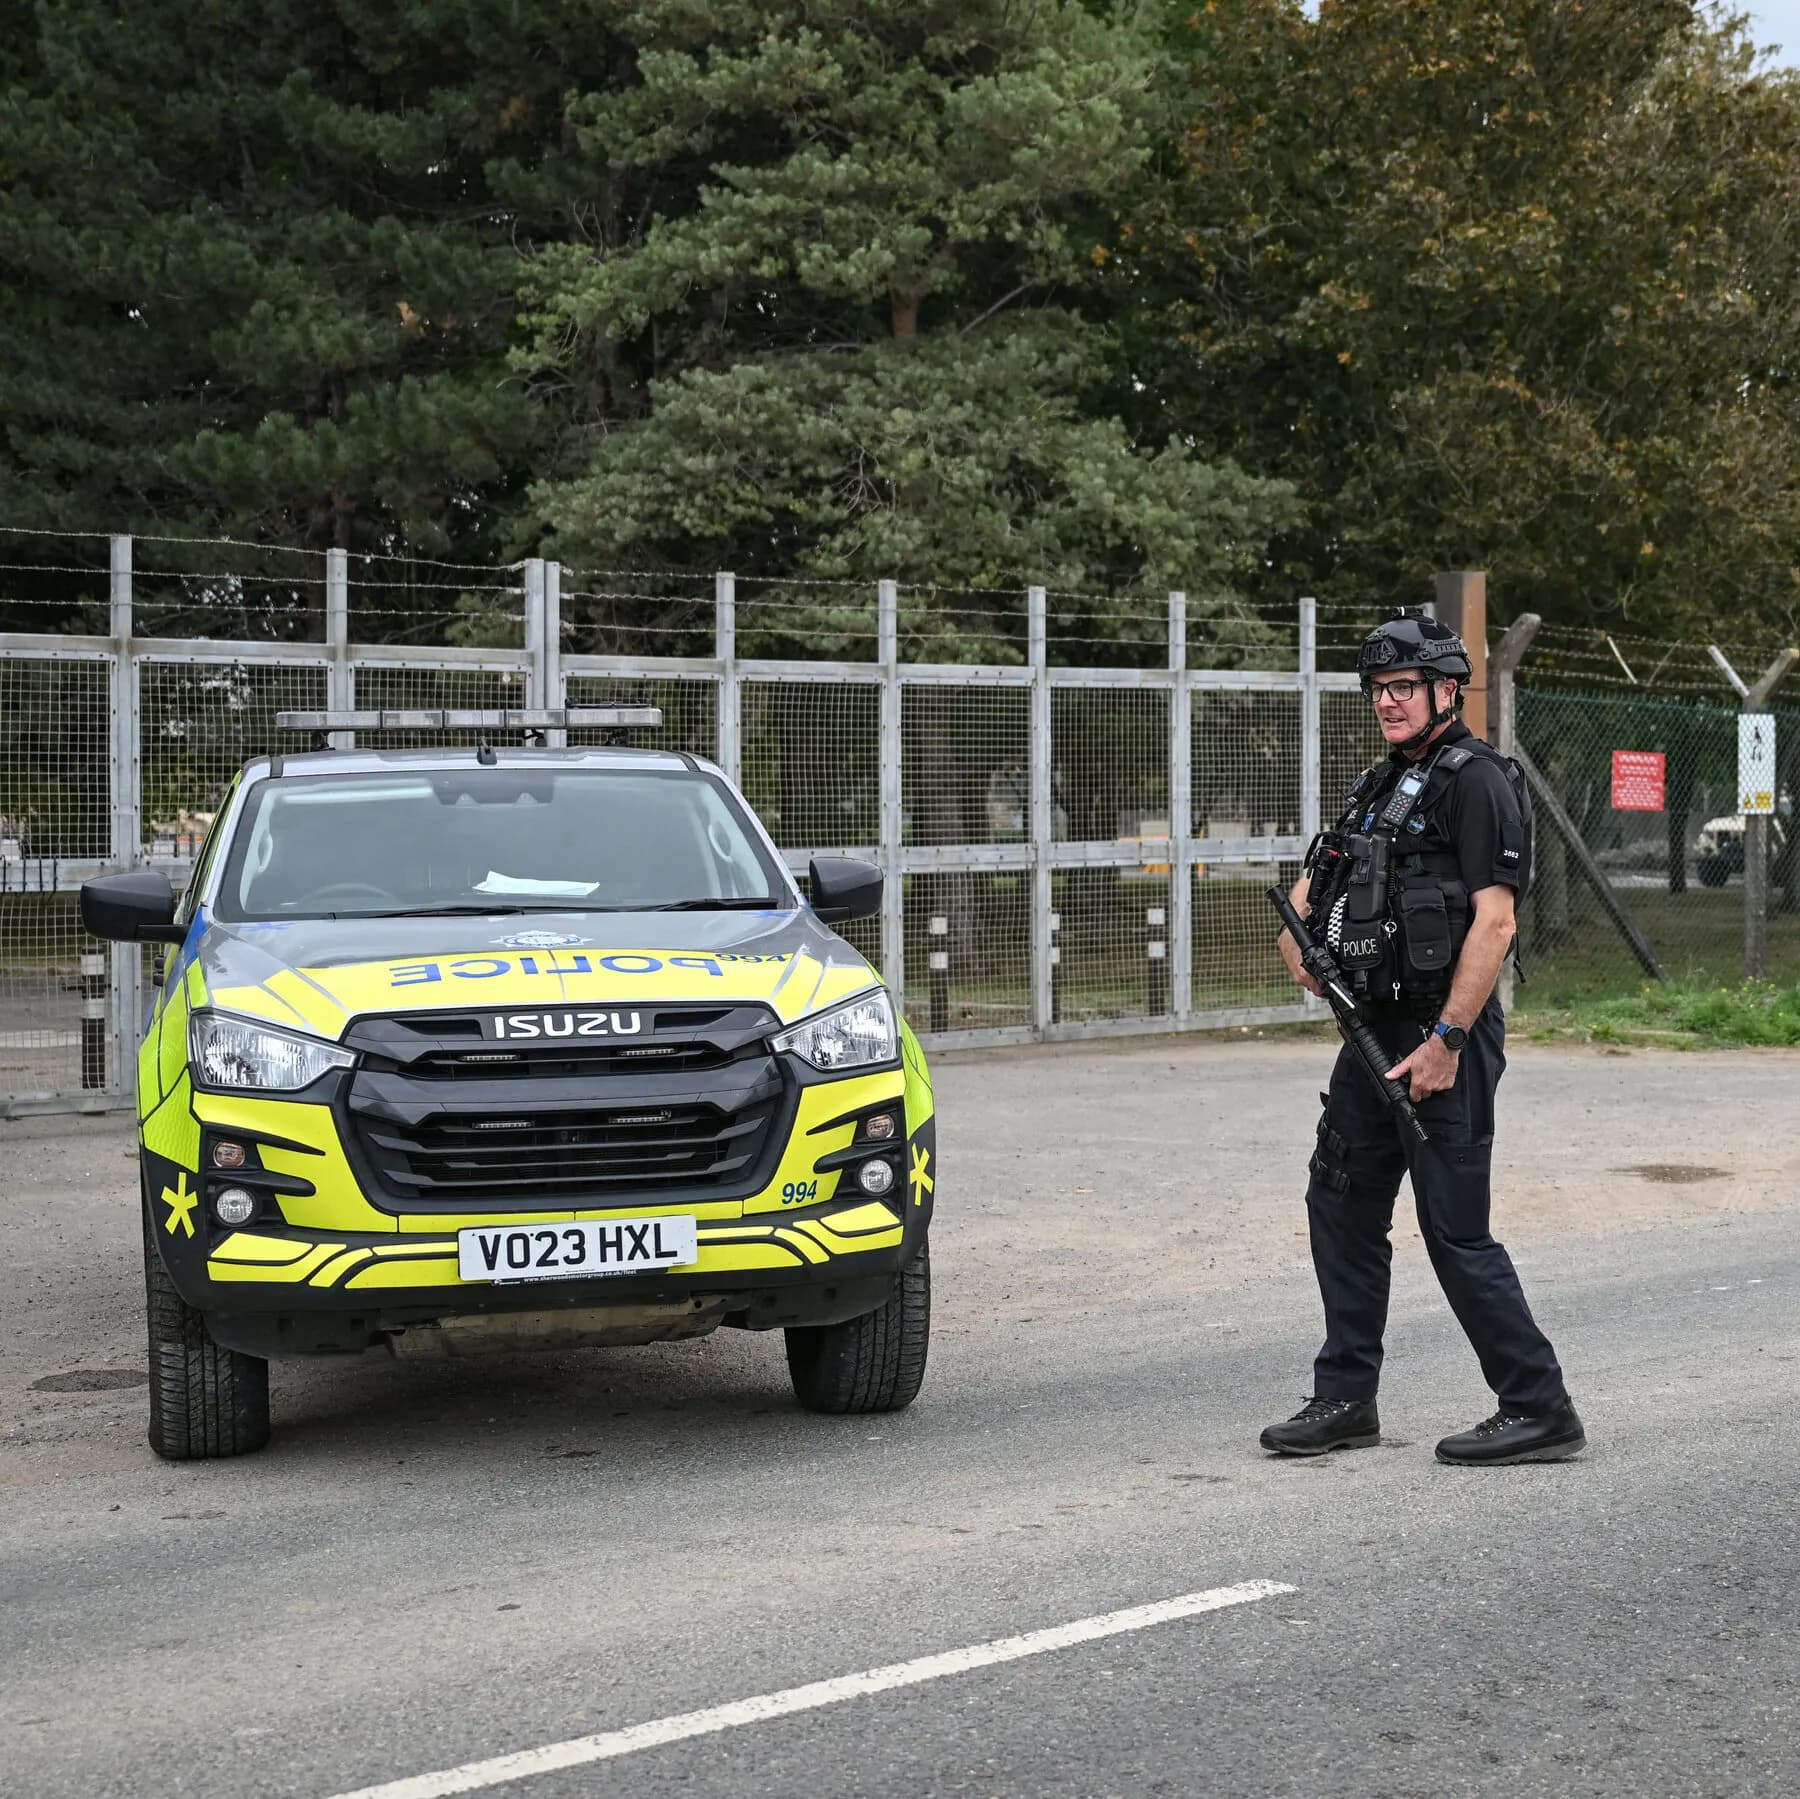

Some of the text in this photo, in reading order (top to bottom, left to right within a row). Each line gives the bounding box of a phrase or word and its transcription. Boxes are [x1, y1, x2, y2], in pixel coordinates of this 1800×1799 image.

[714, 952, 787, 963] 994
[1343, 938, 1378, 957] POLICE
[495, 1011, 642, 1039] ISUZU
[781, 1179, 818, 1205] 994
[478, 1222, 678, 1271] VO23 HXL
